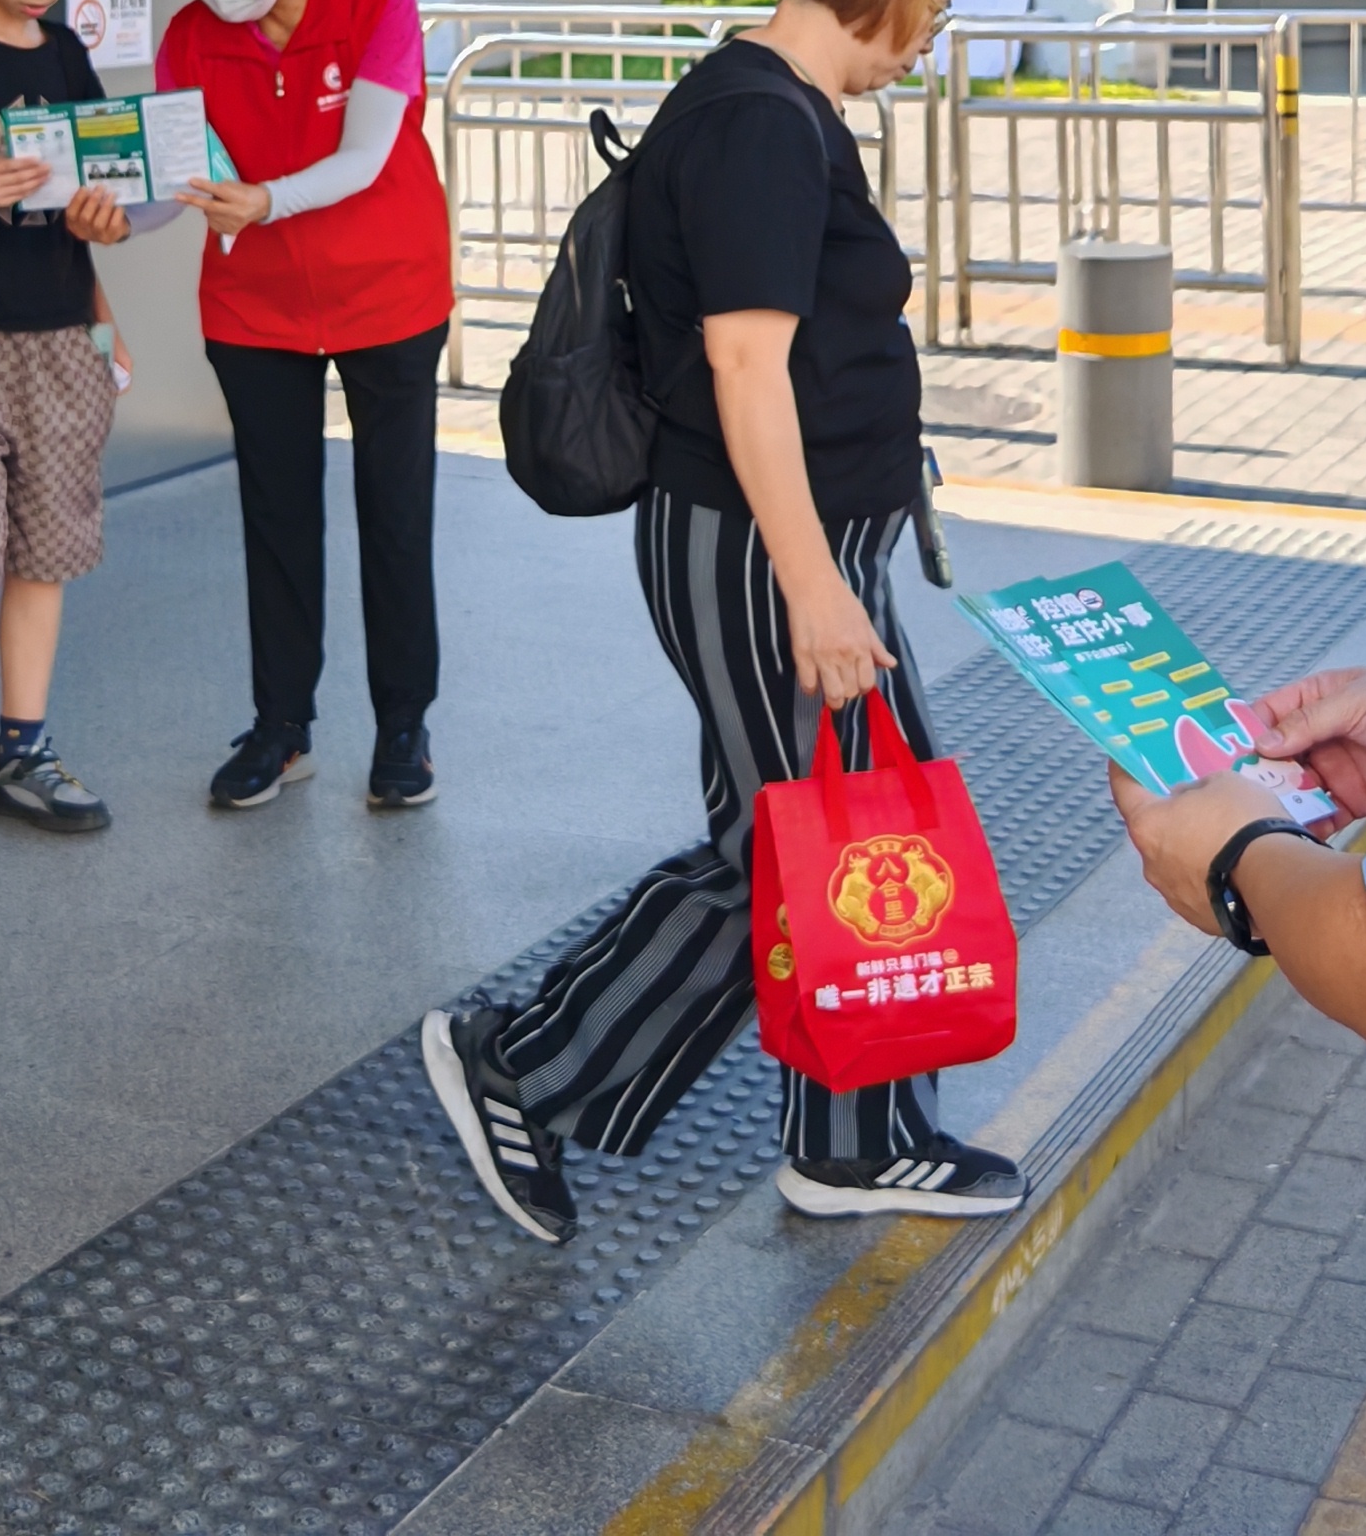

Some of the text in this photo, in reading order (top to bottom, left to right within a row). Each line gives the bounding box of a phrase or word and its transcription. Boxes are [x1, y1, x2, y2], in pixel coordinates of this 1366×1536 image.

[876, 856, 906, 921] 八合里
[814, 961, 995, 1011] 唯一非遗才正宗
